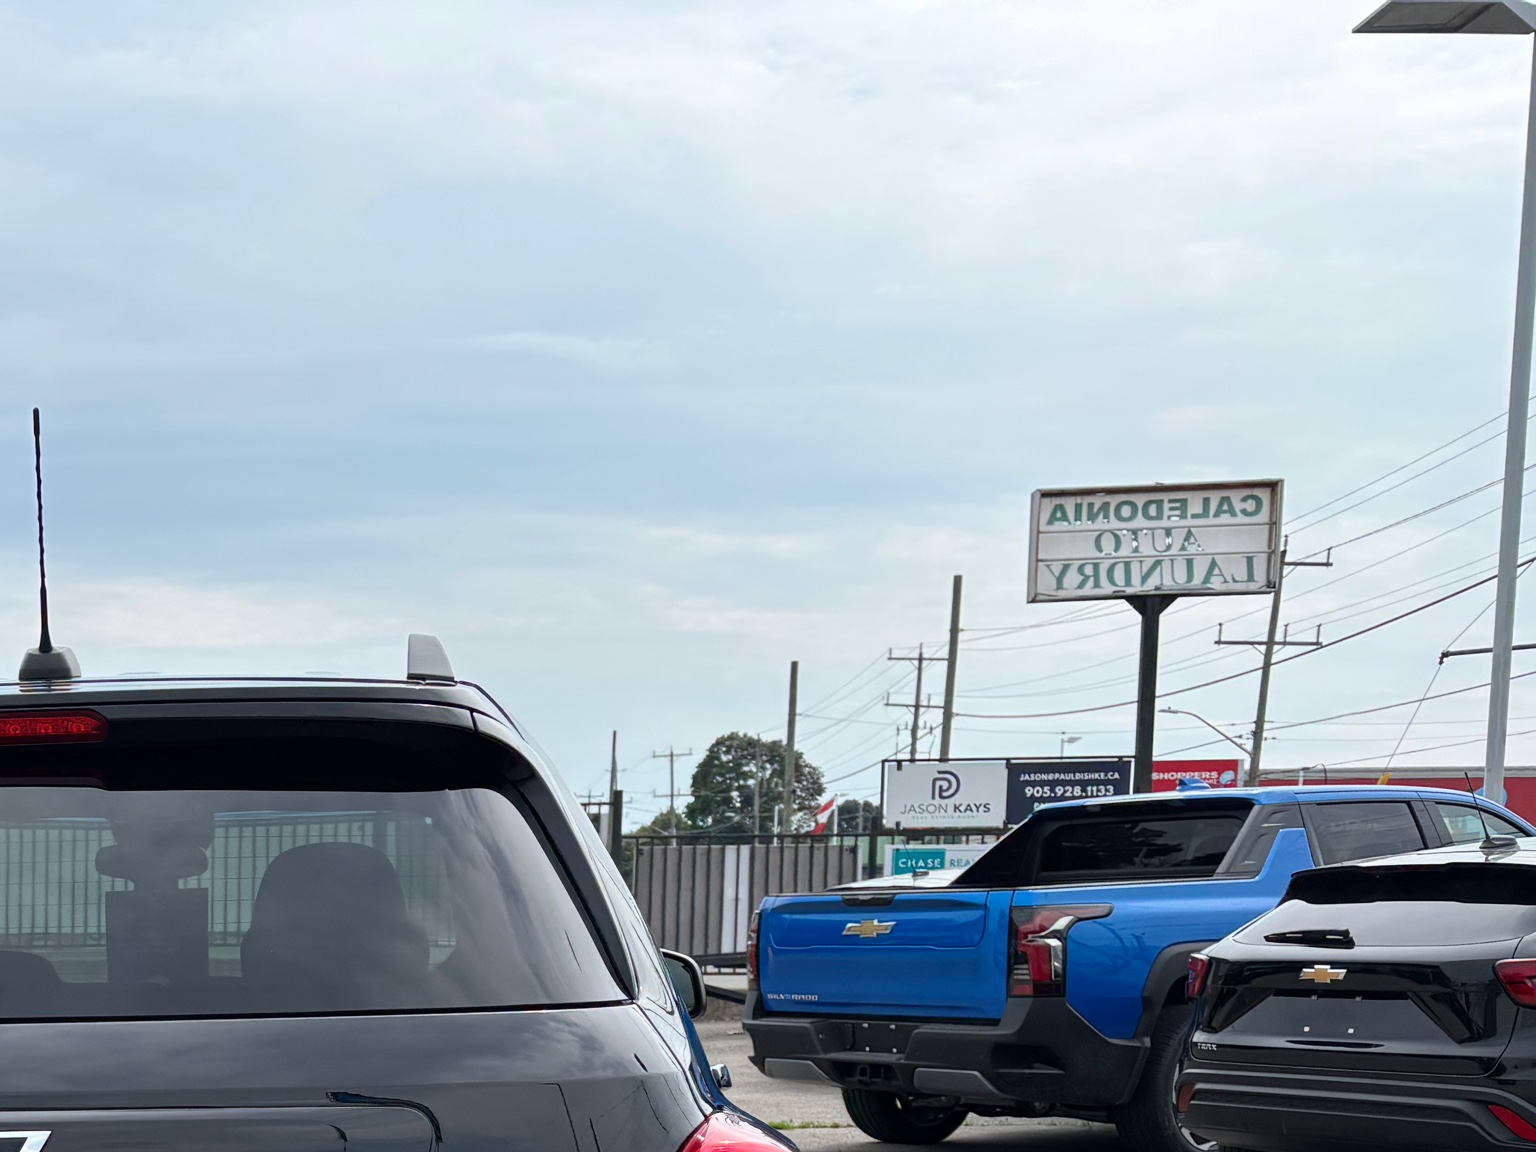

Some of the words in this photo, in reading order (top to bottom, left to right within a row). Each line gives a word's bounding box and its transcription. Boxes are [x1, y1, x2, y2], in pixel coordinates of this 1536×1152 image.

[1019, 771, 1120, 781] JASON@PAULDISHKE.CA
[1151, 771, 1218, 780] SHOPPERS
[1024, 785, 1115, 797] 905.928.1133
[900, 803, 948, 815] JASON
[954, 803, 991, 813] KAYS
[899, 858, 941, 868] CHASE
[949, 858, 974, 868] REA
